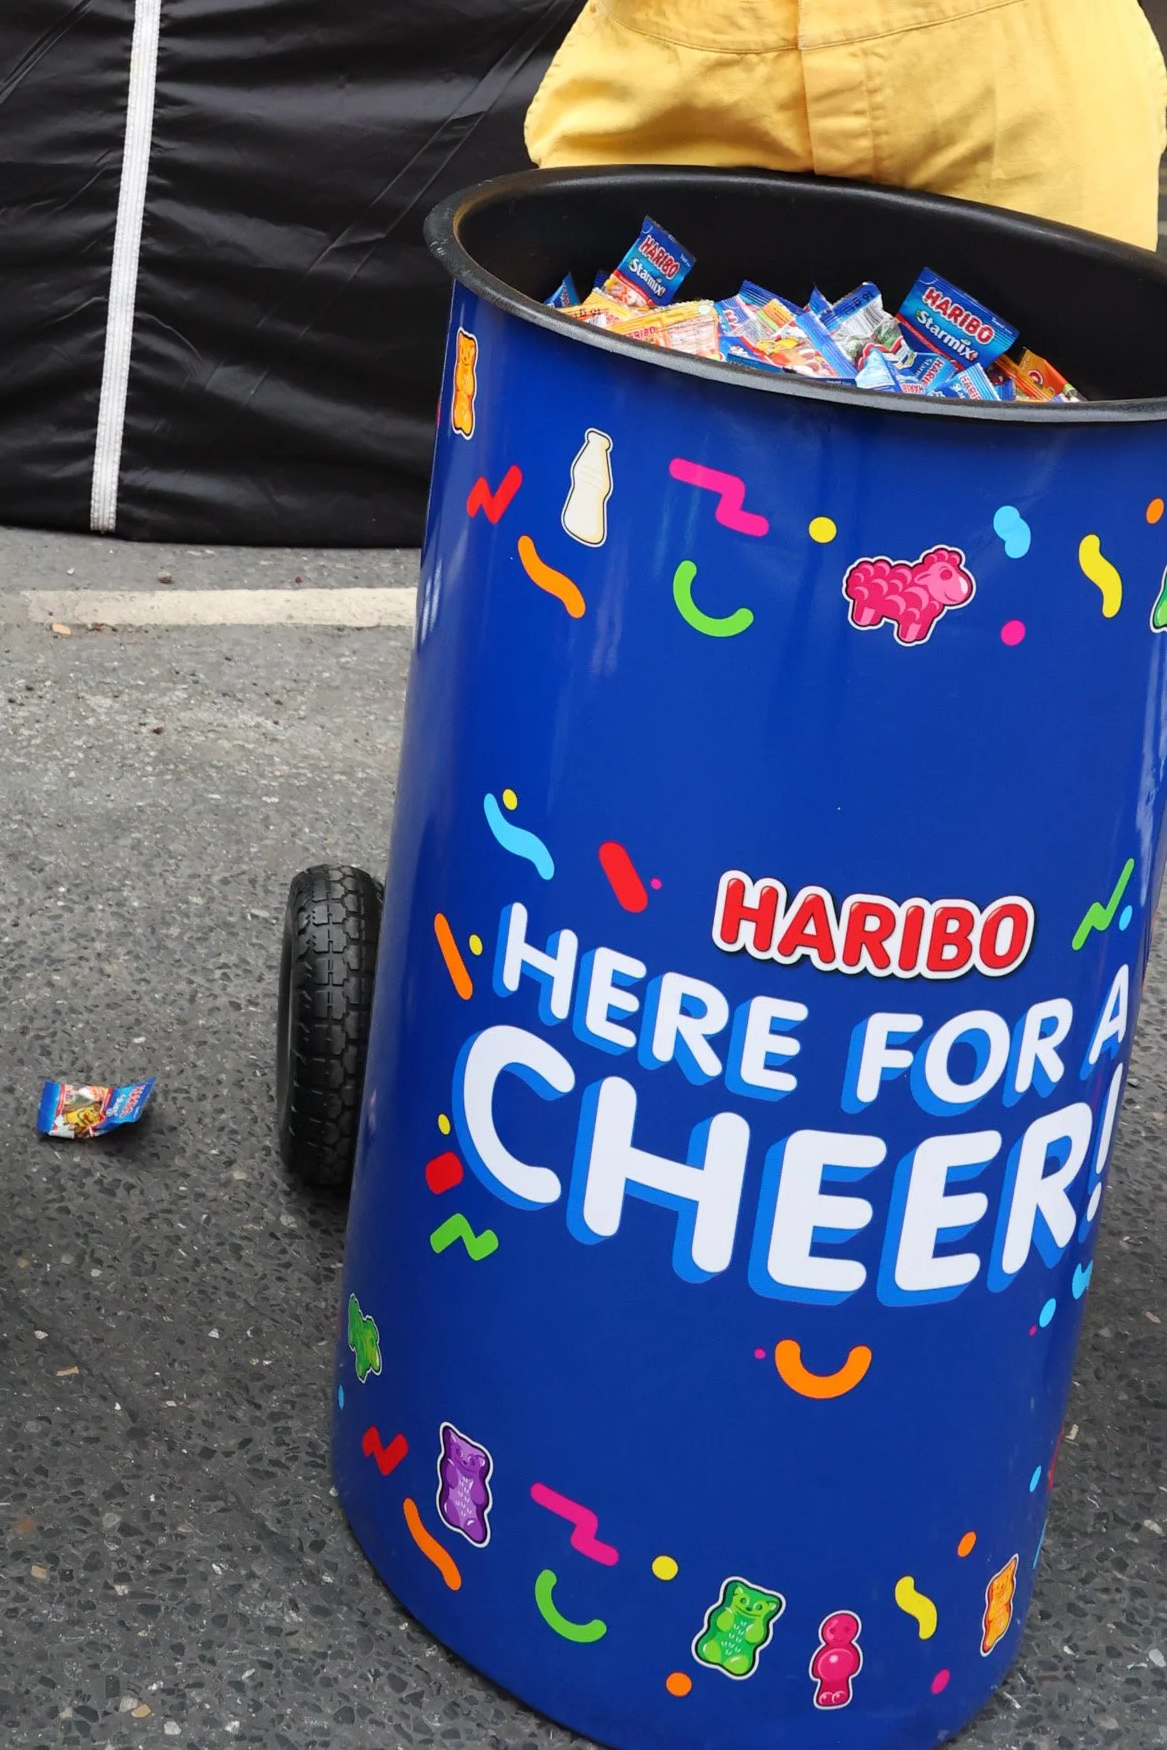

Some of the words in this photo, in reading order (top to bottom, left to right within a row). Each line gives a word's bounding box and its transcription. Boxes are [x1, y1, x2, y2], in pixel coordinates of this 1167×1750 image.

[628, 258, 664, 298] Starmix
[639, 235, 681, 281] HARIBO
[916, 309, 976, 362] Starmix
[922, 286, 995, 346] HARIBO
[712, 870, 1035, 979] HARIBO
[493, 902, 808, 1102] HERE
[841, 997, 1073, 1117] FOR
[1079, 964, 1130, 1081] A
[452, 1024, 1123, 1307] CHEER!
